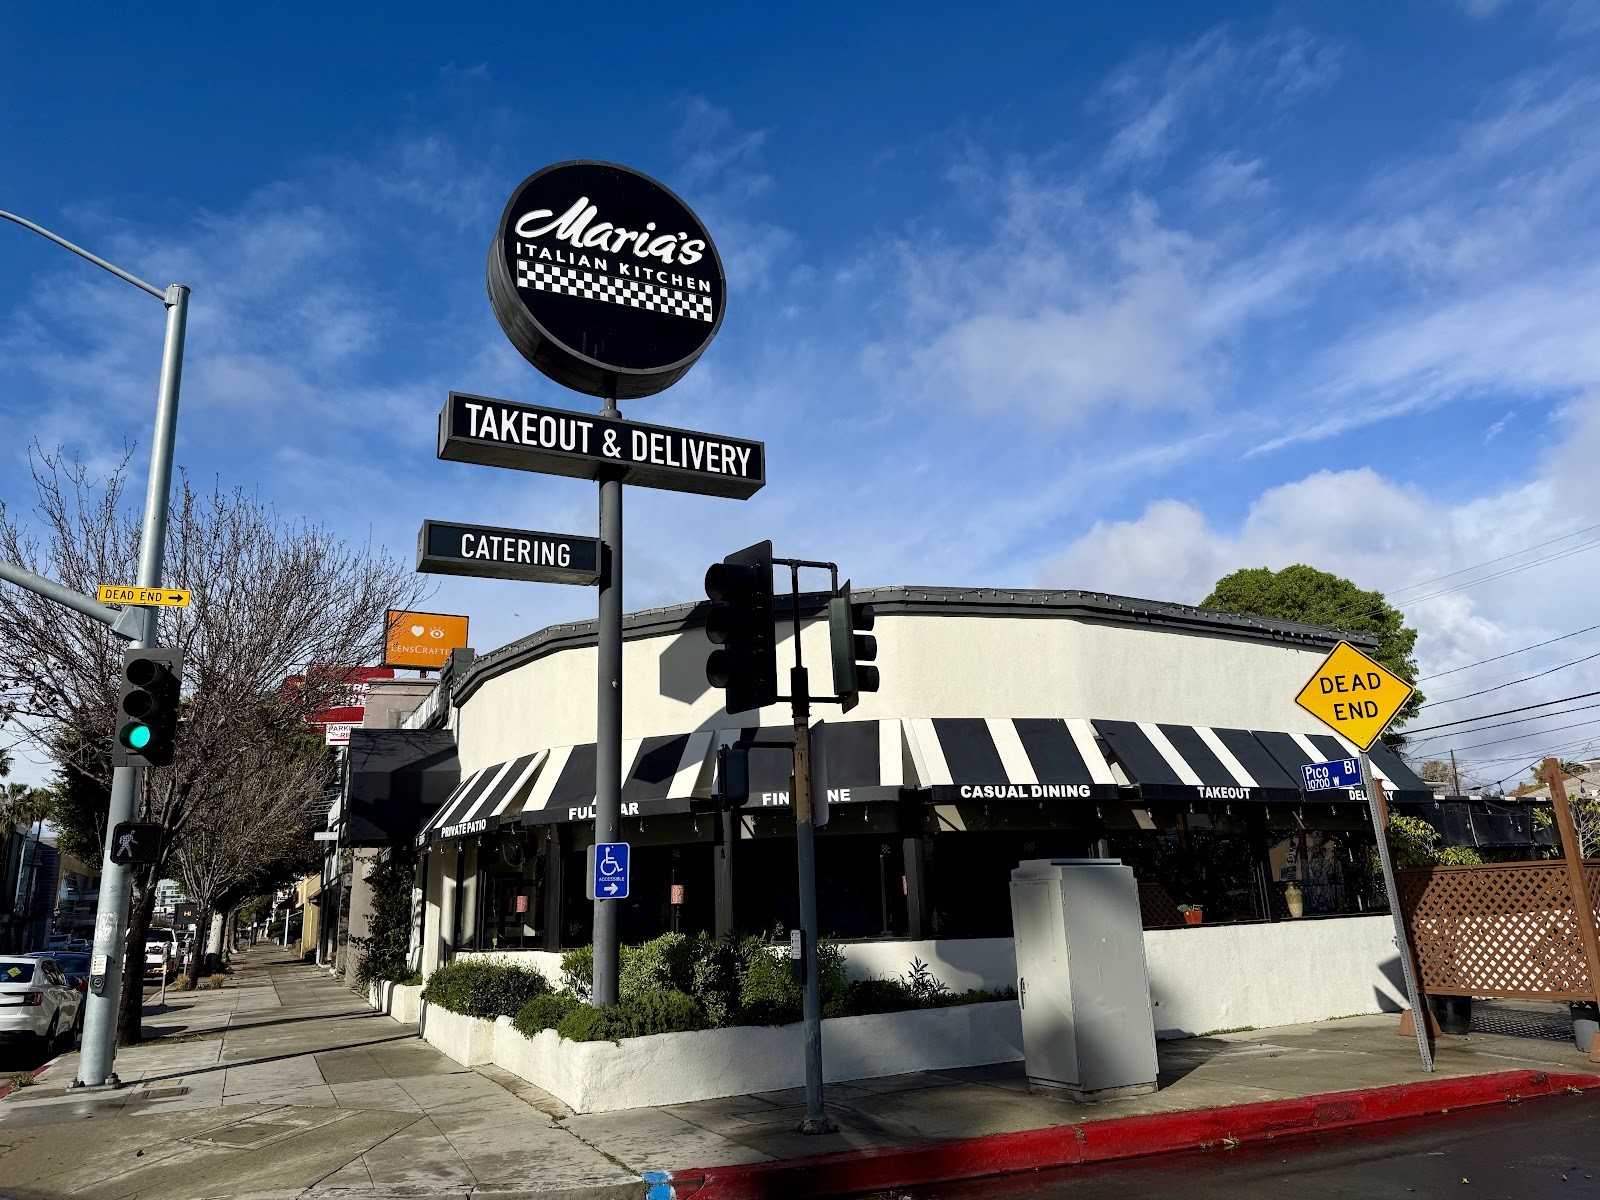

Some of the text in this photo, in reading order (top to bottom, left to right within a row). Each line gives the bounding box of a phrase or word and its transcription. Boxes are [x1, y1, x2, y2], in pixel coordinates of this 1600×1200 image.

[515, 196, 706, 265] Maria's
[516, 242, 711, 293] ITALIAN KITCHEN
[465, 402, 751, 477] TAKEOUT & DELIVERY
[461, 533, 571, 567] CATERING
[105, 589, 162, 602] DEAD END
[391, 643, 450, 656] LENSCRAFTE
[1319, 672, 1381, 694] DEAD
[1333, 700, 1378, 721] END
[960, 784, 1091, 799] CASUAL DINING
[1307, 776, 1340, 790] 10700 W
[762, 788, 851, 806] FIN NE
[1197, 786, 1251, 800] TAKEOUT
[568, 802, 640, 821] FUL AR
[441, 818, 487, 838] PRIVATE PATIO
